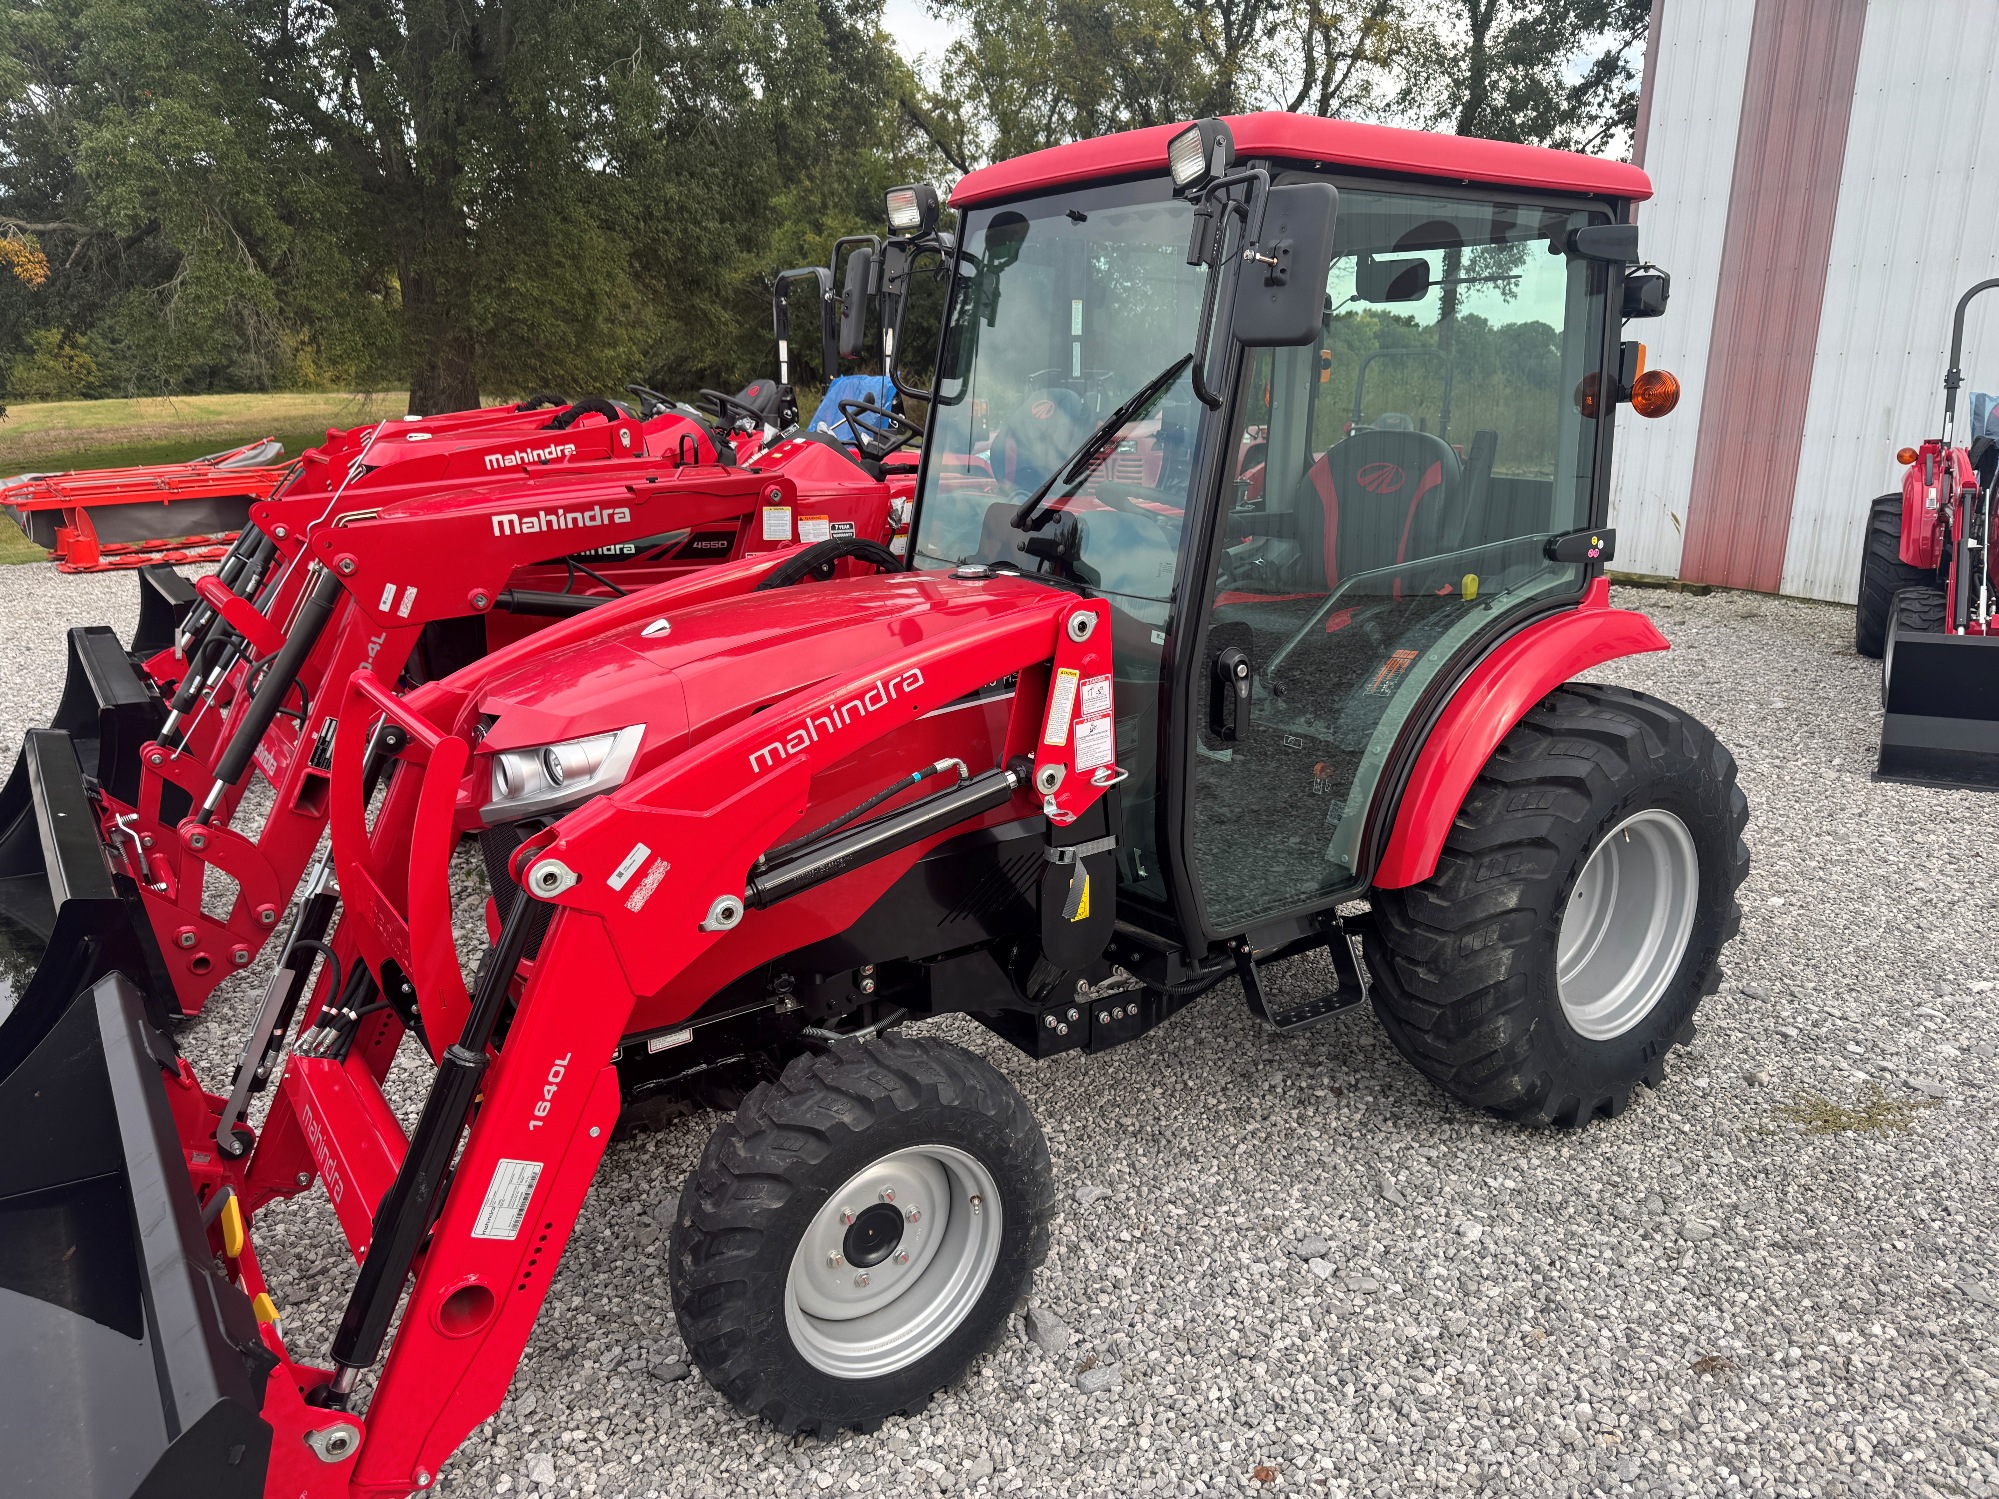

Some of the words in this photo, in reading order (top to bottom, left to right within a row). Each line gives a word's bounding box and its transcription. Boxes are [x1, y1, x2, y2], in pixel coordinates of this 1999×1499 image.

[484, 443, 576, 470] Mahindra
[492, 506, 631, 537] Mahindra
[692, 540, 728, 549] 4550
[748, 668, 925, 774] mahindra
[528, 1052, 572, 1131] 1640L
[302, 1104, 345, 1204] mahindra
